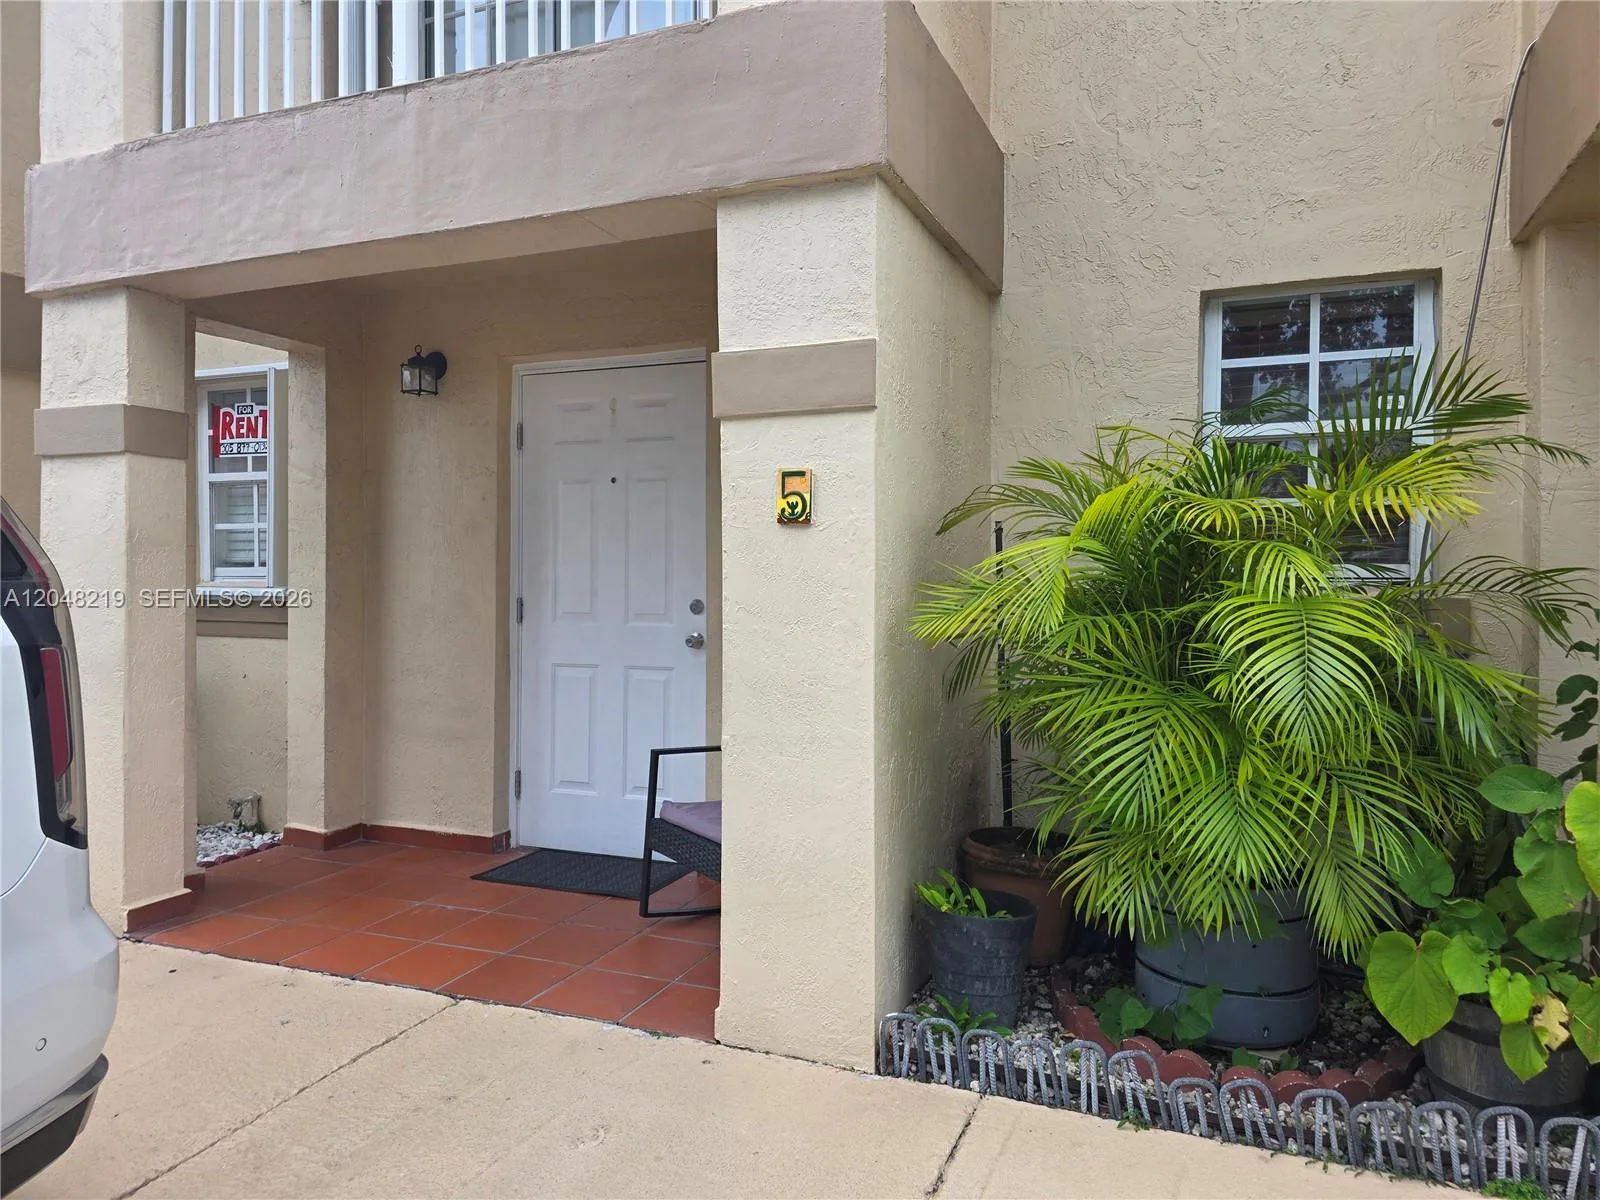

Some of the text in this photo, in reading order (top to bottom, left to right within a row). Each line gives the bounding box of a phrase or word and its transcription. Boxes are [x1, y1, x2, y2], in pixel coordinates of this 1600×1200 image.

[221, 409, 268, 440] RENT
[238, 406, 252, 414] FOR
[781, 471, 807, 521] 5
